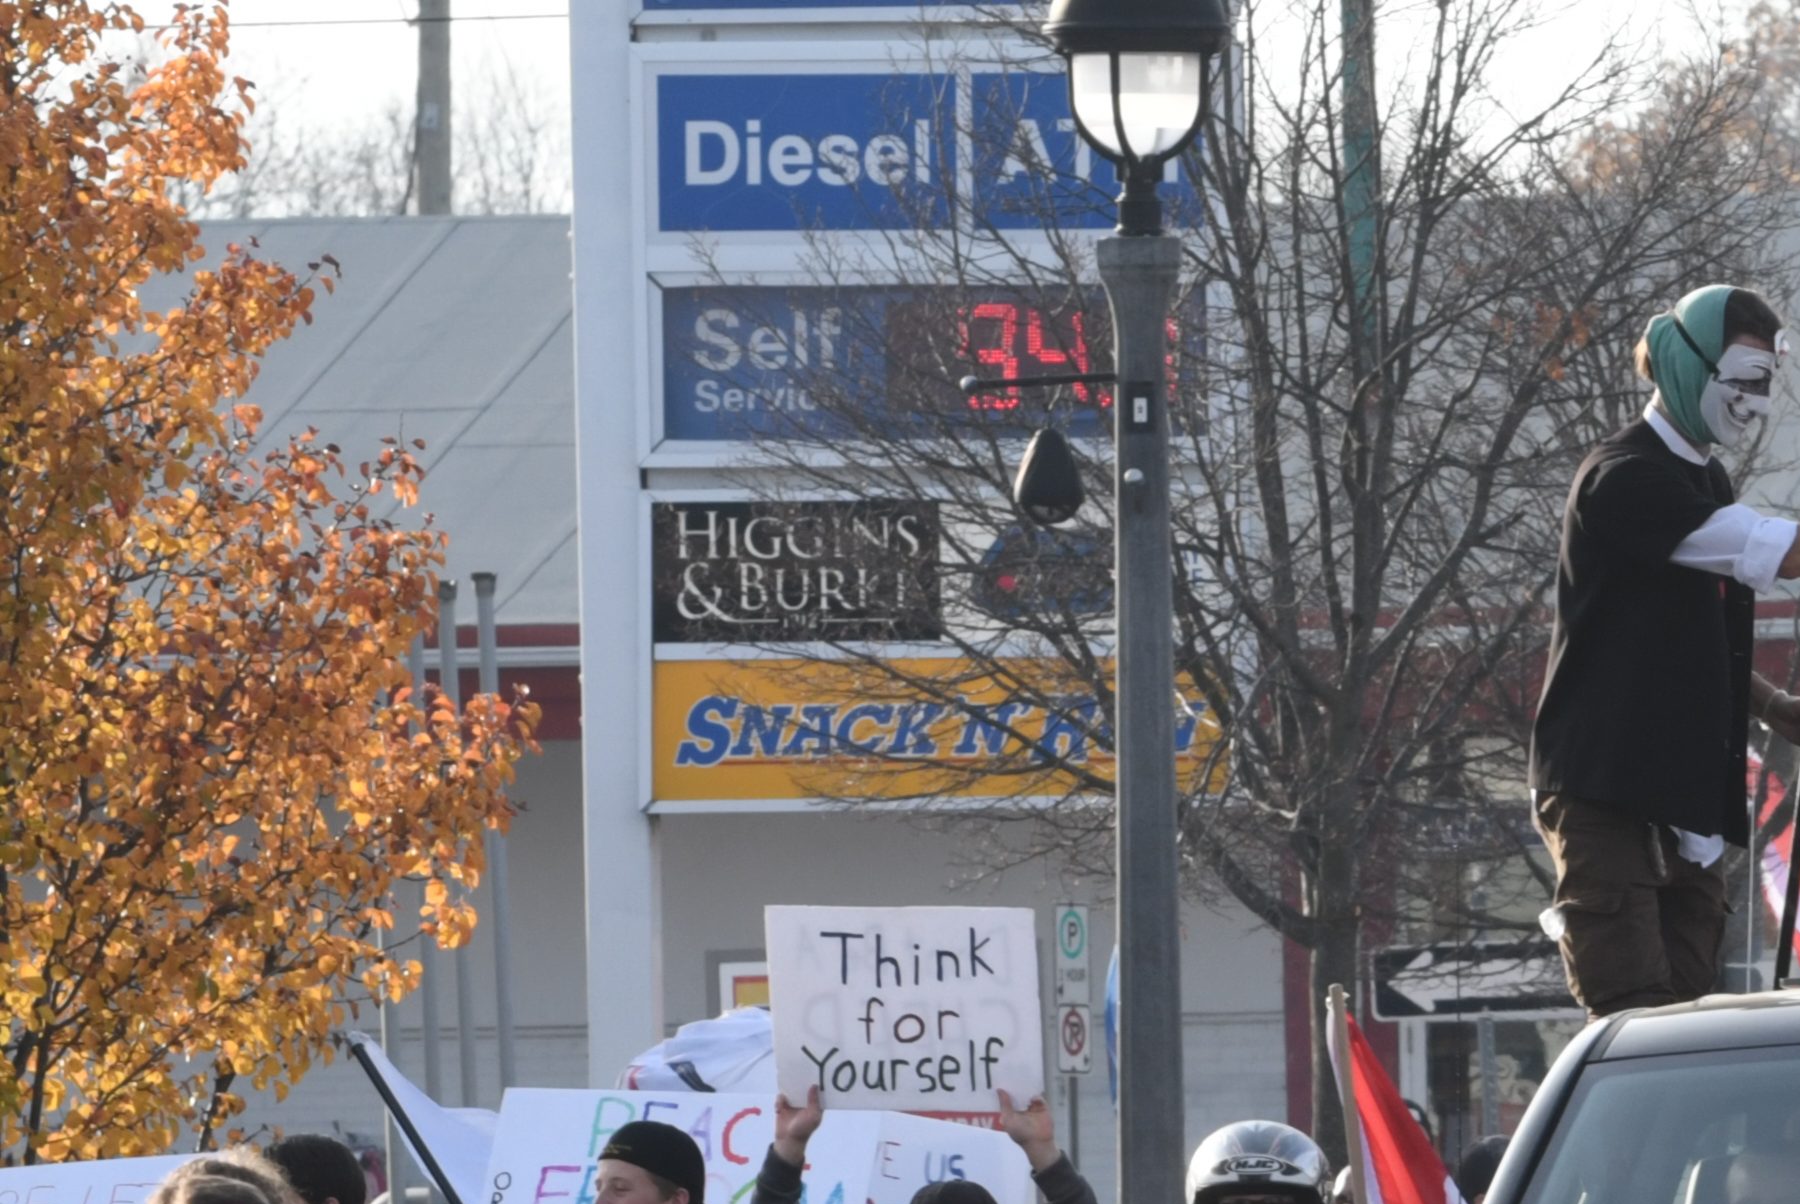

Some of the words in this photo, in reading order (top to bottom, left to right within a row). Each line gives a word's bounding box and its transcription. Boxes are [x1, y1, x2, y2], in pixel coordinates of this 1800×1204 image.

[684, 119, 932, 186] Diesel
[997, 119, 1178, 184] AT
[694, 308, 842, 373] Self
[694, 379, 822, 412] Servic
[675, 509, 920, 559] HIGGINS
[673, 695, 945, 768] SNACK
[820, 927, 995, 988] Think
[858, 997, 960, 1045] for
[801, 1037, 1005, 1093] Yourself
[586, 1096, 812, 1173] PAC
[924, 1151, 966, 1185] US
